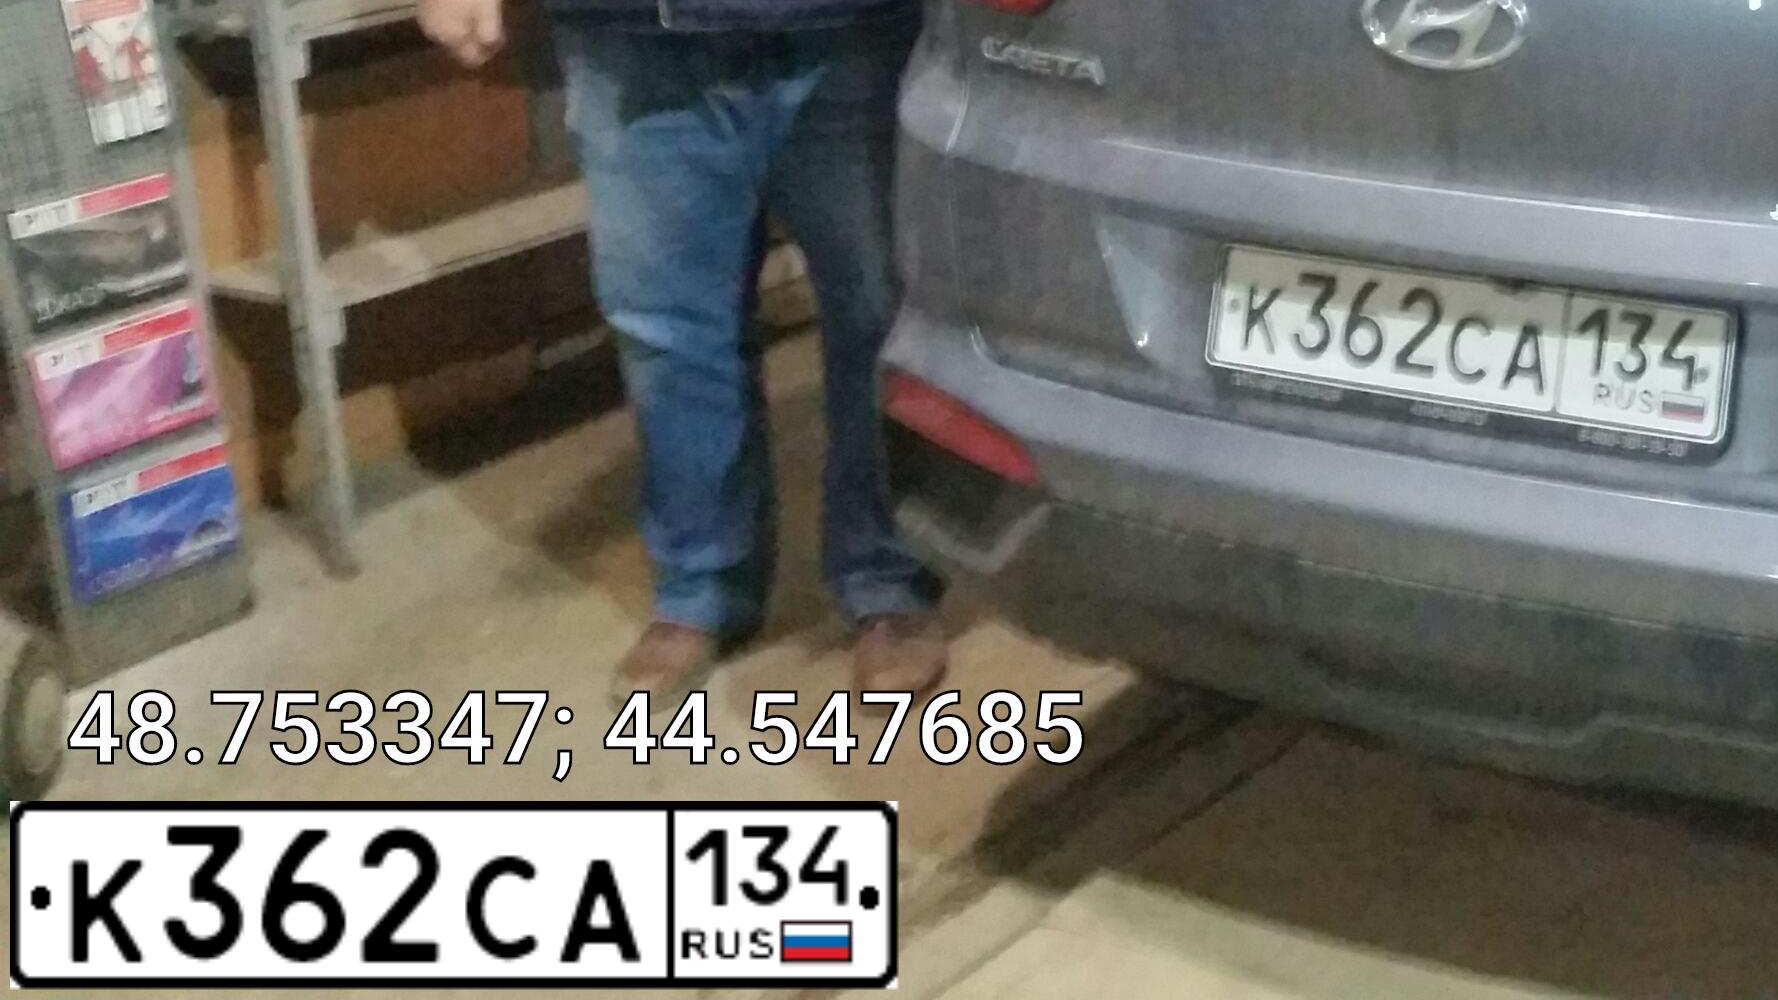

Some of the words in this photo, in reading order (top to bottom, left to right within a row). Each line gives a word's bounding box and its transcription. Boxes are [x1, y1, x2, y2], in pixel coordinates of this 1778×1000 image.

[1239, 272, 1546, 396] К362СА
[1576, 307, 1697, 391] 134
[1593, 381, 1655, 415] RUS
